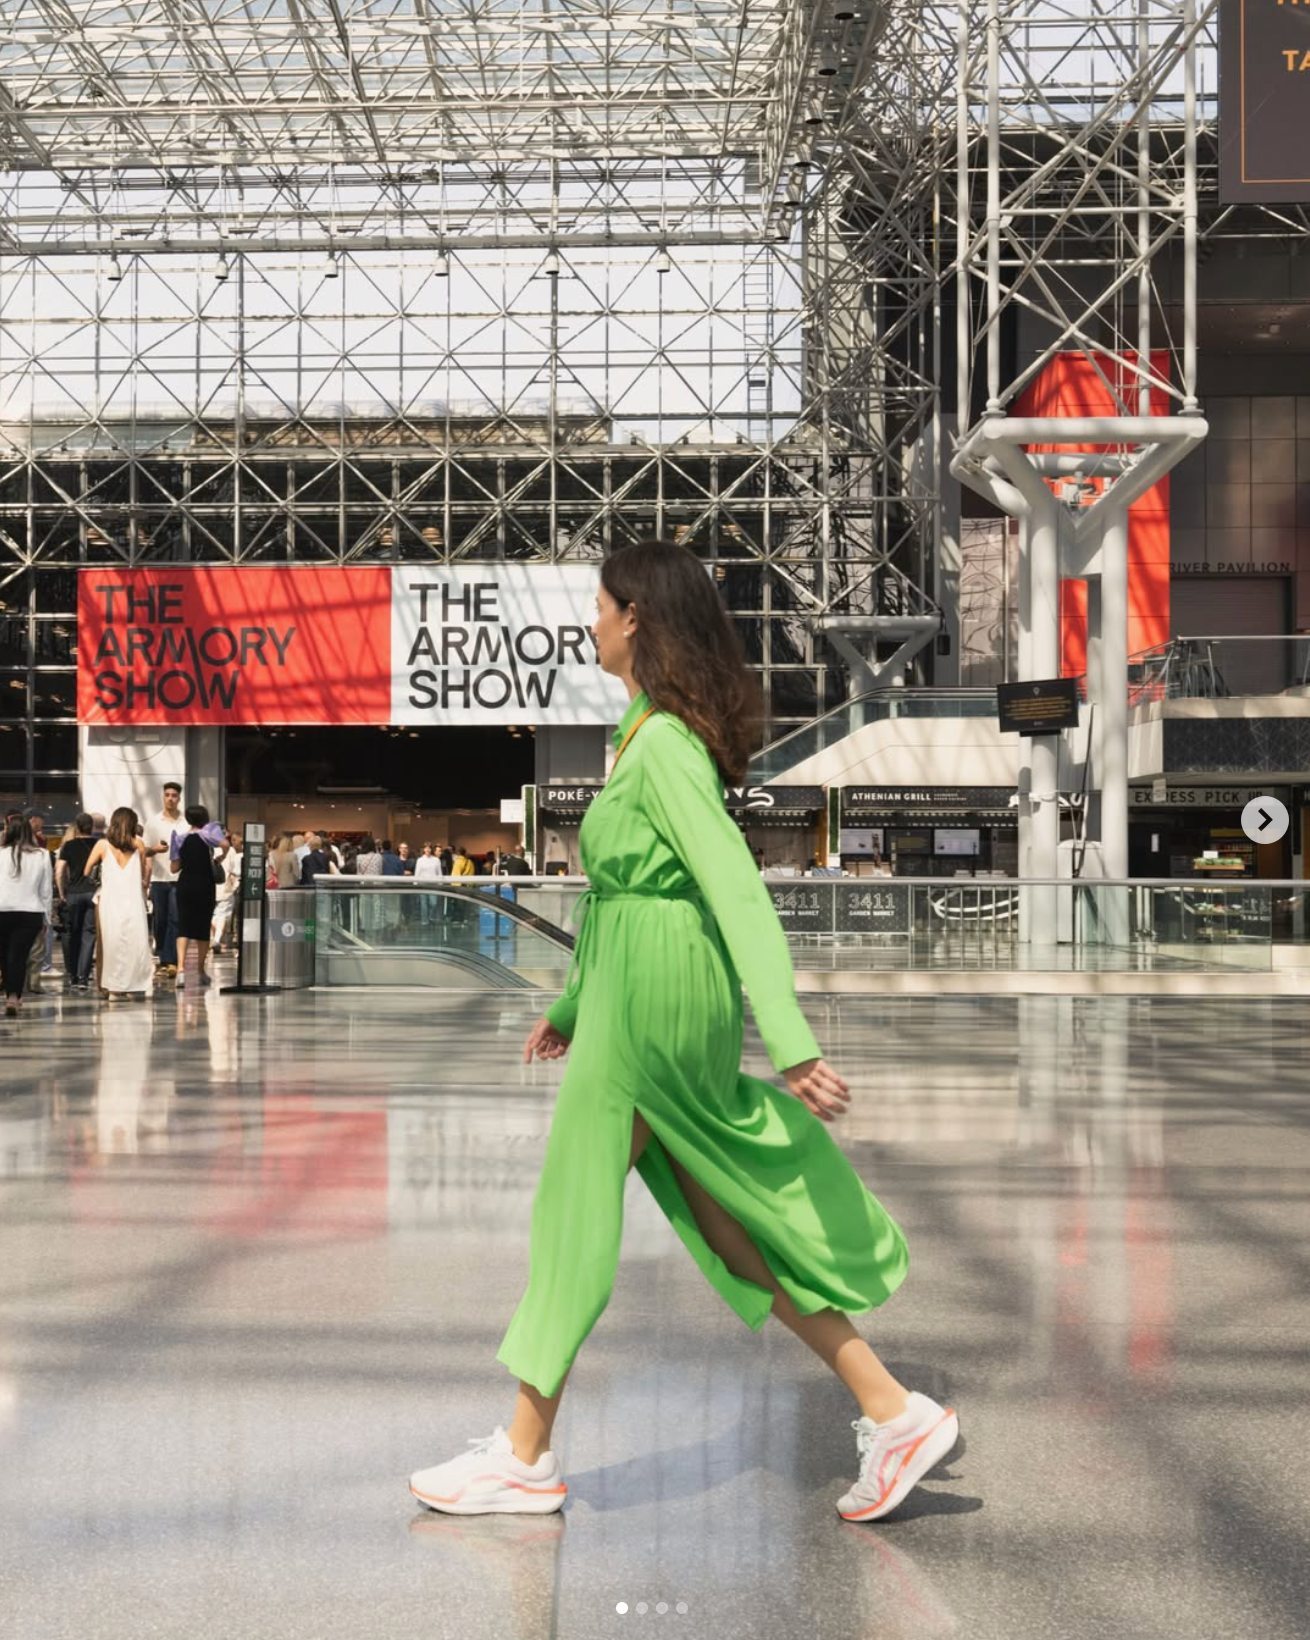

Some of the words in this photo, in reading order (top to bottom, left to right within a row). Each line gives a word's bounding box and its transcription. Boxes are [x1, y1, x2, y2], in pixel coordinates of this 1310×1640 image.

[1169, 562, 1210, 573] RIVER
[1217, 562, 1290, 573] PAVILION
[95, 585, 184, 624] THE
[409, 582, 500, 622] THE
[94, 627, 296, 667] ARMORY
[95, 670, 240, 710] SHOW
[409, 668, 557, 709] SHOW
[1135, 792, 1195, 803] EXESS
[1205, 792, 1240, 803] PICK
[773, 892, 820, 909] 3411
[848, 892, 896, 909] 3411
